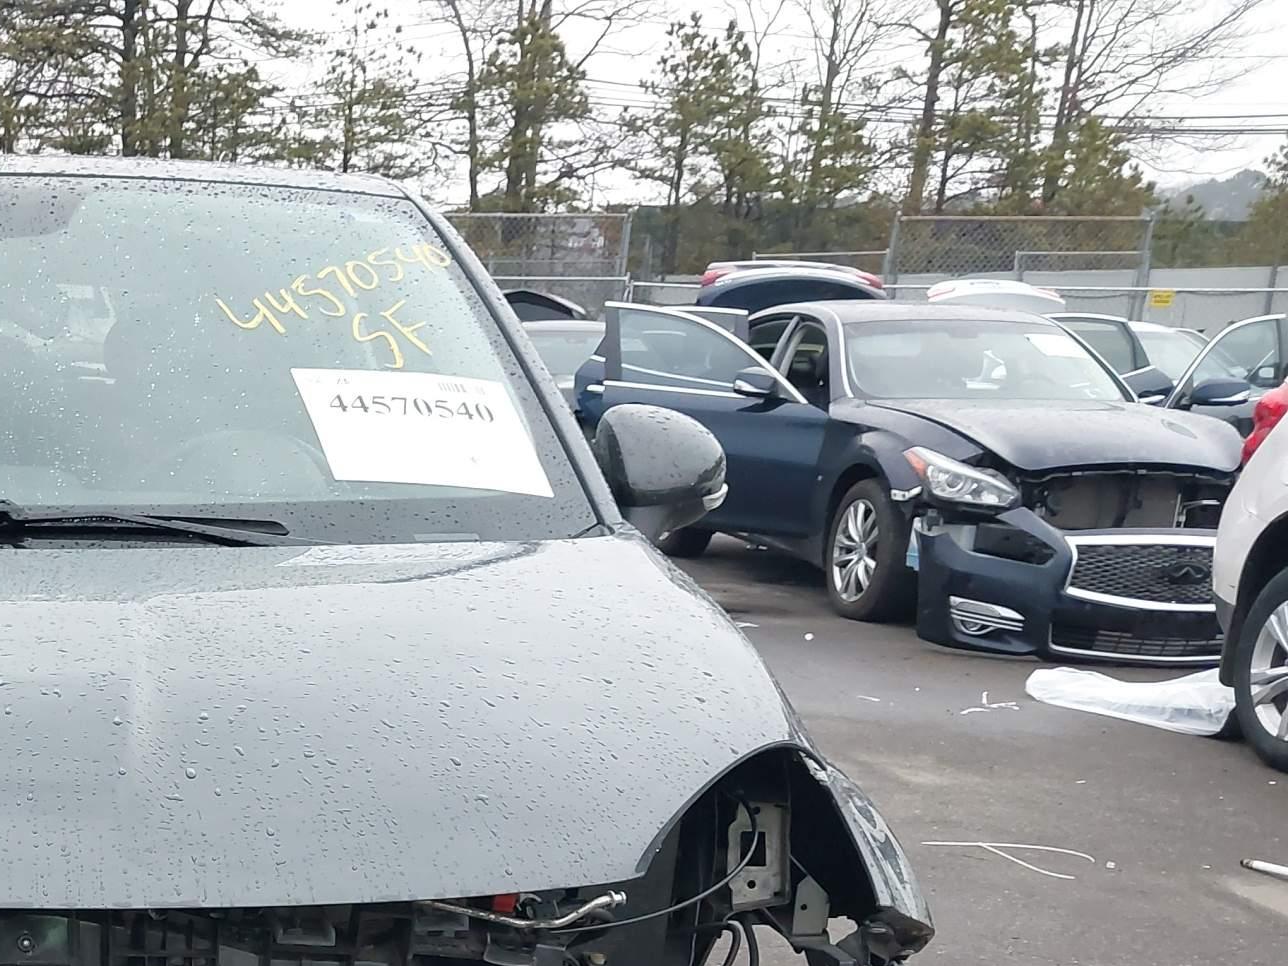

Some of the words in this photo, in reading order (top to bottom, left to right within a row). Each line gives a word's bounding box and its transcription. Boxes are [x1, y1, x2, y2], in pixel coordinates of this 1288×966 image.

[215, 241, 453, 335] 44570540
[352, 299, 433, 369] SF
[329, 393, 495, 423] 44570540
